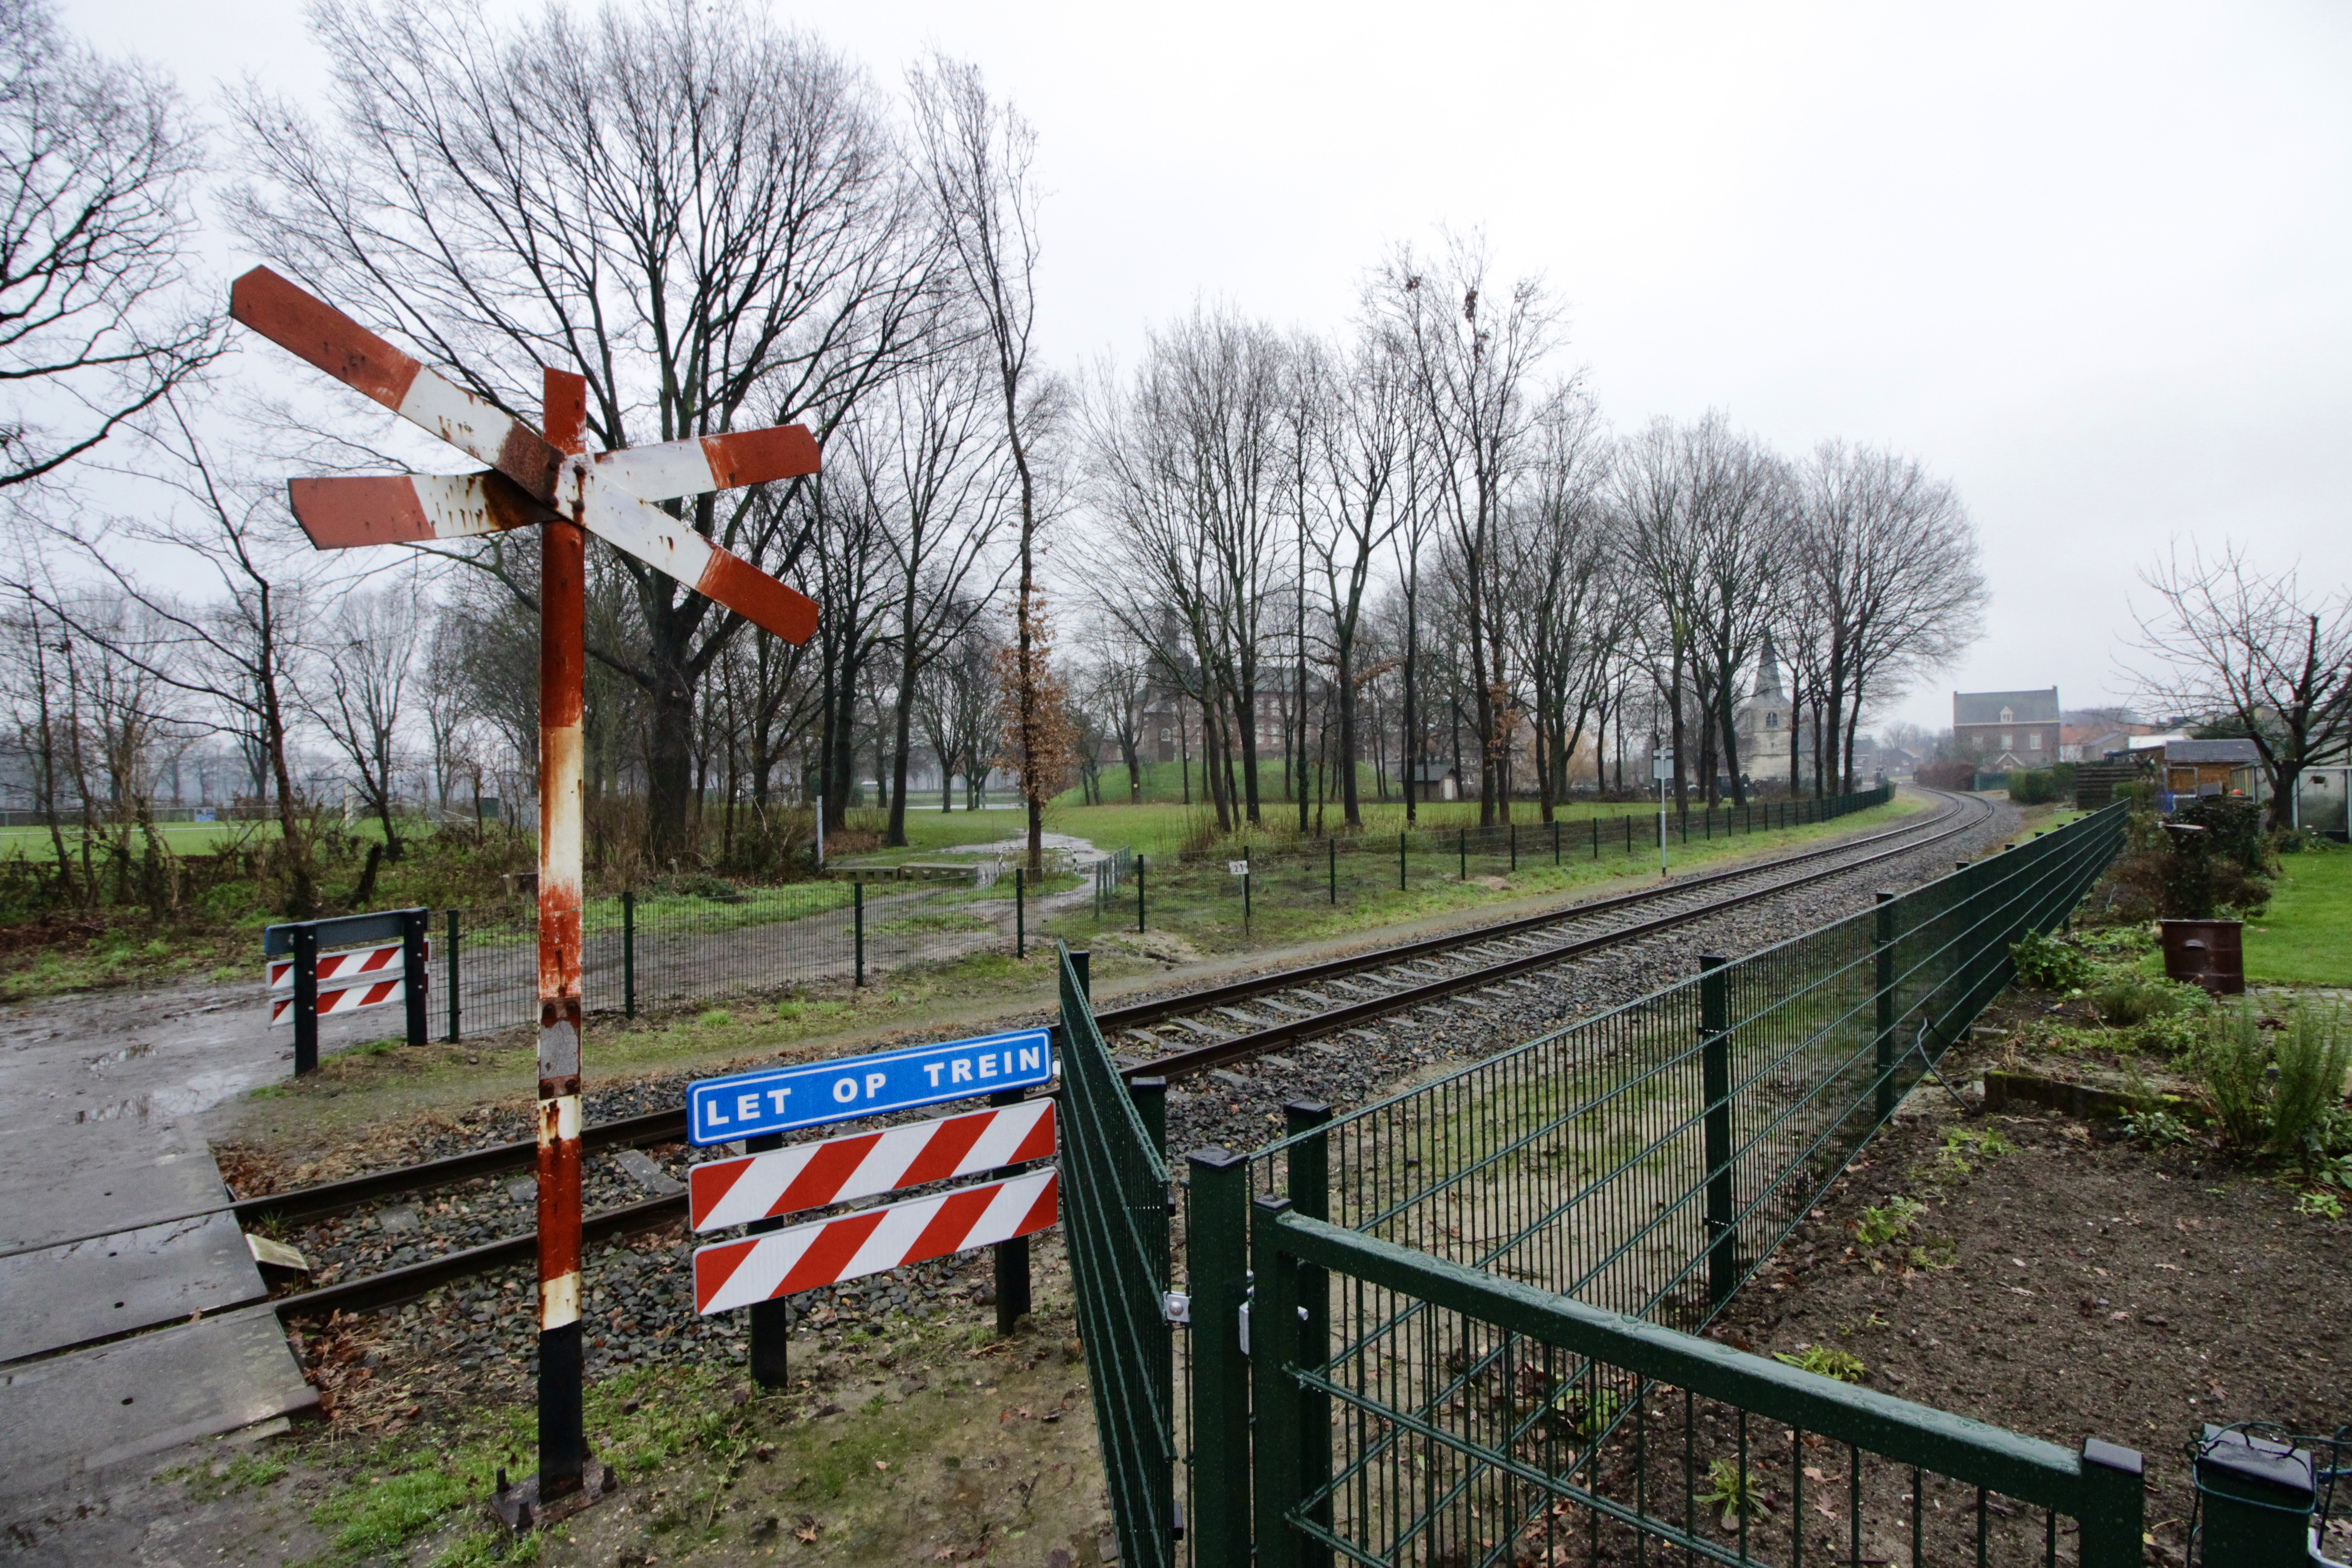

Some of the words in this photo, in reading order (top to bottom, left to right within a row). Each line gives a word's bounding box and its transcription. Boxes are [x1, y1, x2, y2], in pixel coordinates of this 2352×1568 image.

[707, 1088, 791, 1126] LET
[833, 1073, 886, 1102] OP
[924, 1047, 1040, 1087] TREIN
